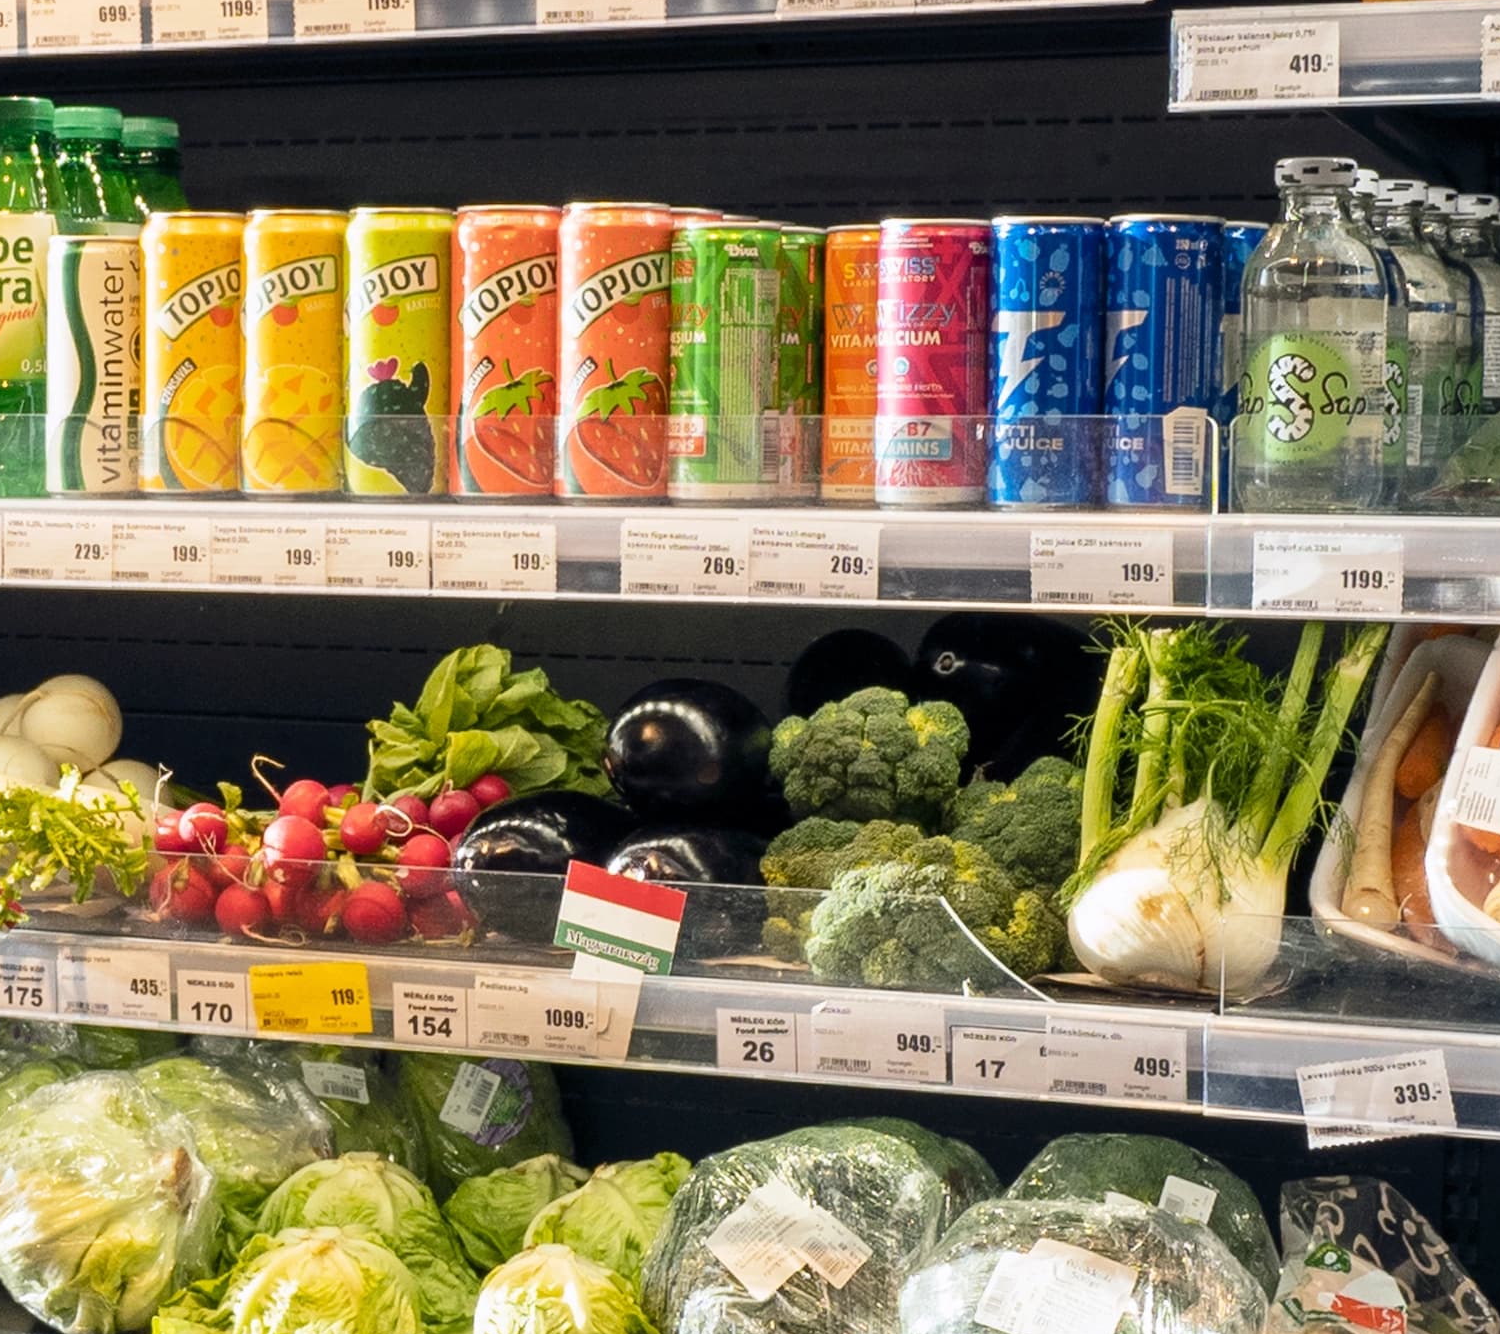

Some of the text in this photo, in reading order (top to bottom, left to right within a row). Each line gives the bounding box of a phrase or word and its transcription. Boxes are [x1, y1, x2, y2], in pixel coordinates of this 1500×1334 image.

[97, 260, 125, 486] vitaminwater
[566, 927, 659, 973] Magyarország
[4, 985, 43, 1008] 175
[190, 1002, 233, 1024] 170
[408, 1017, 453, 1040] 154
[742, 1038, 776, 1063] 26
[975, 1057, 1006, 1079] 17
